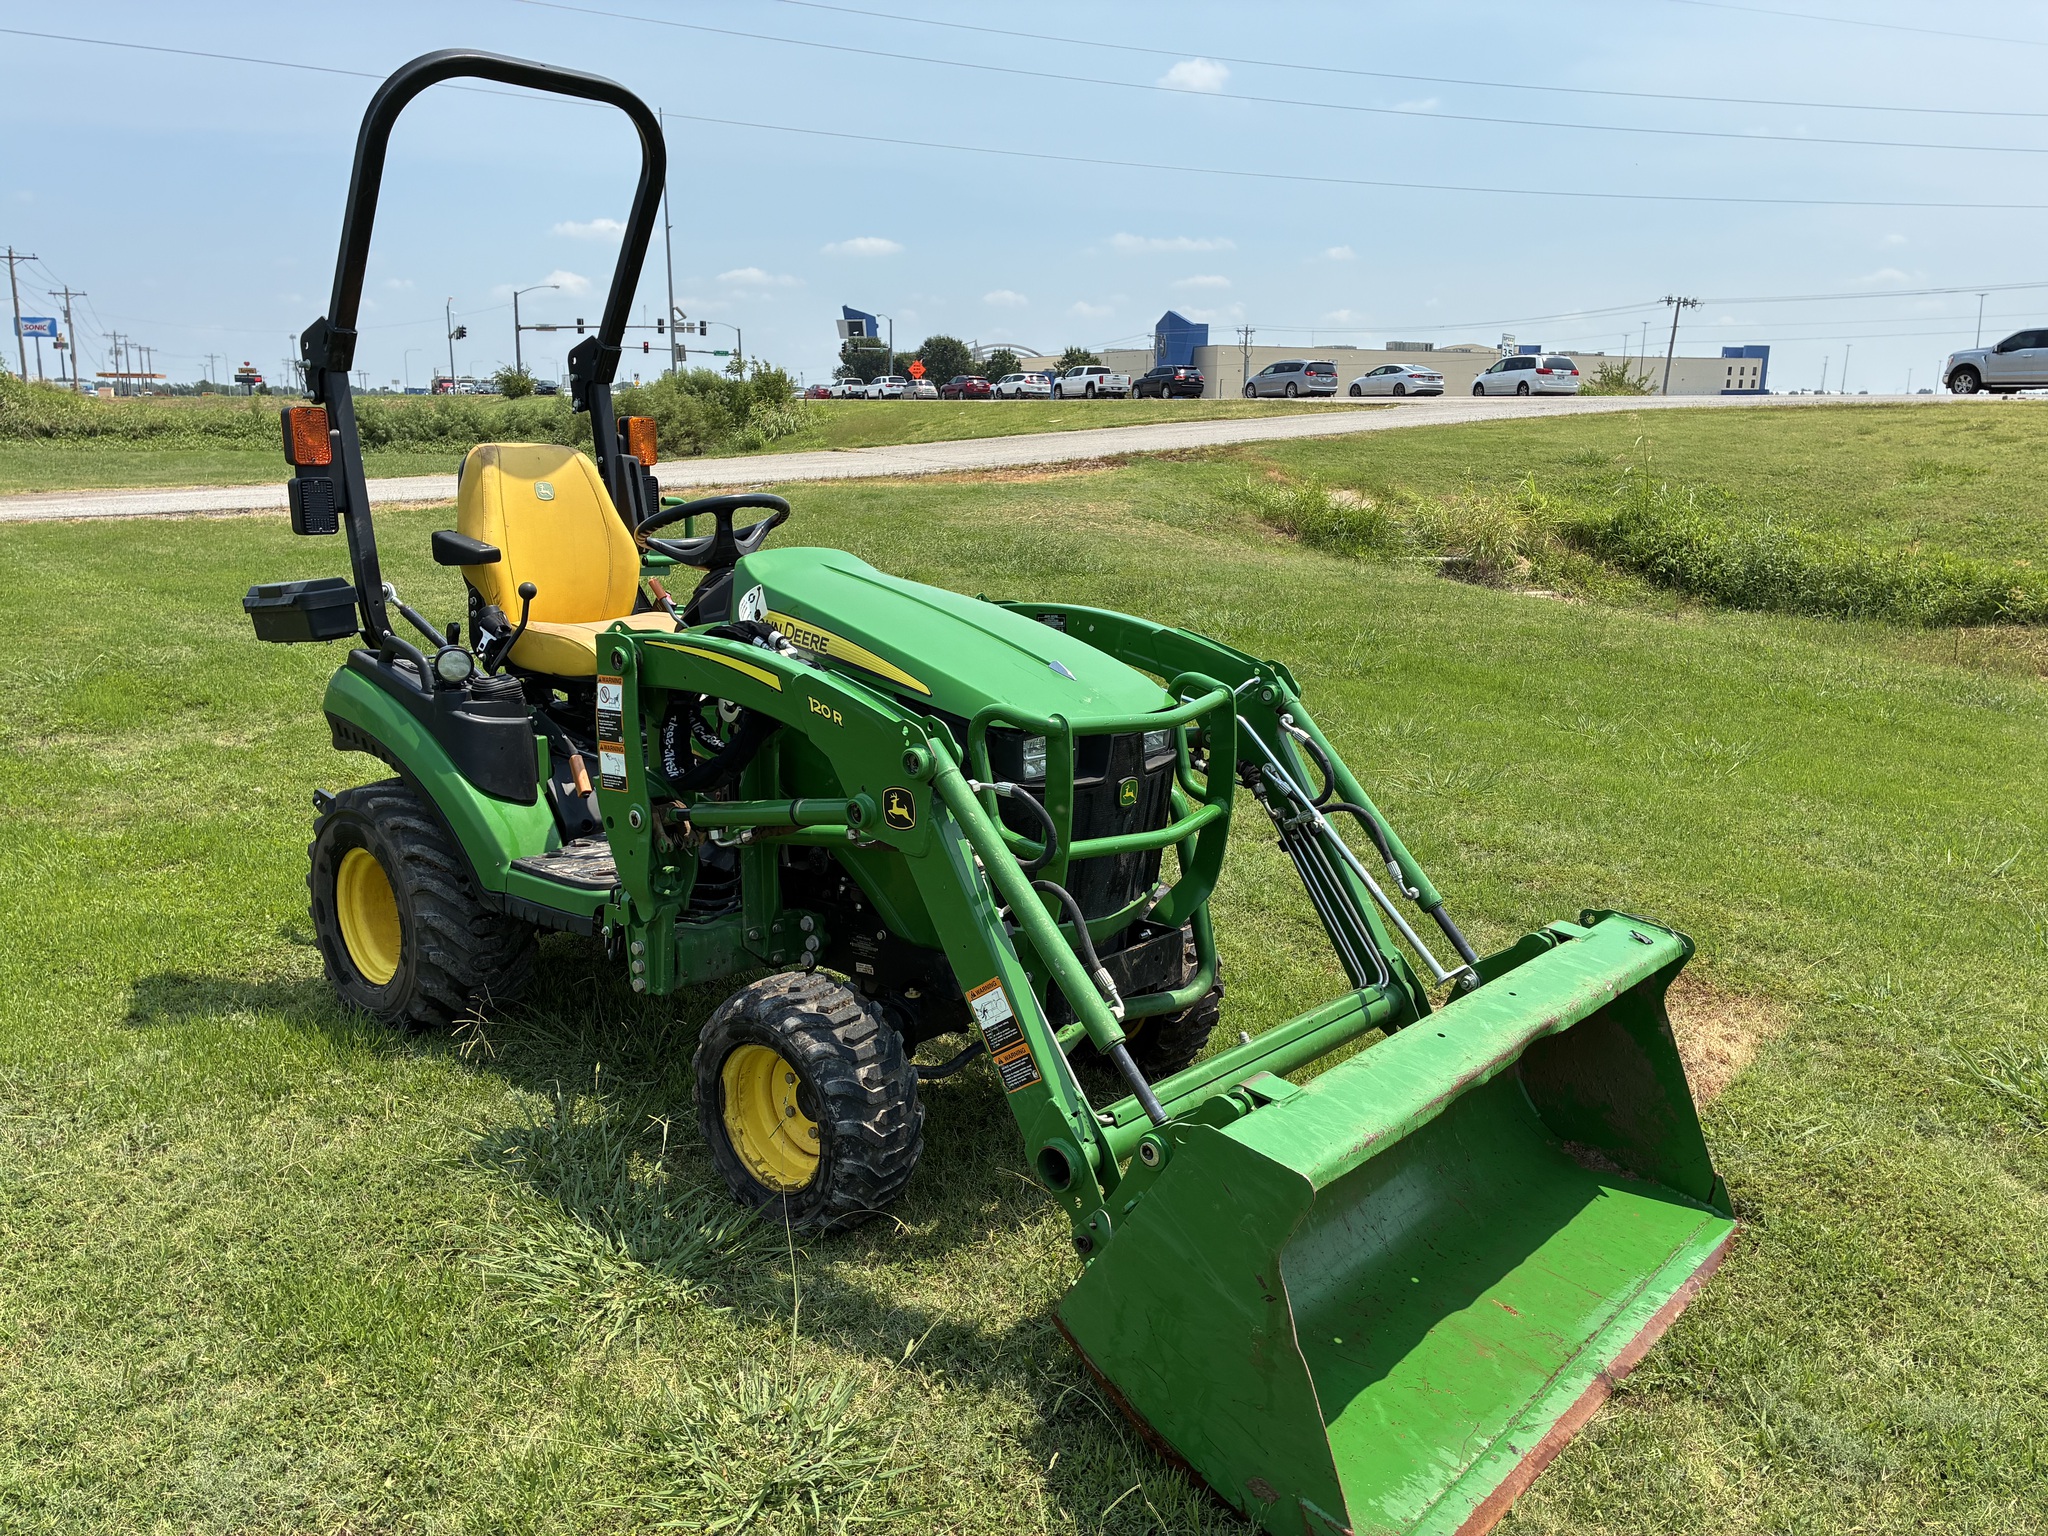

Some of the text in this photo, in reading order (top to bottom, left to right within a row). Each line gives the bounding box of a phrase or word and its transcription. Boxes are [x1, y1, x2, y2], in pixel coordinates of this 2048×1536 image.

[1502, 348, 1514, 357] 35
[784, 622, 830, 653] DEERE
[602, 676, 622, 684] WARNING
[808, 696, 844, 727] 120 R
[602, 744, 624, 753] WARNING
[975, 981, 997, 994] WARNING
[1003, 1048, 1026, 1060] WARNING
